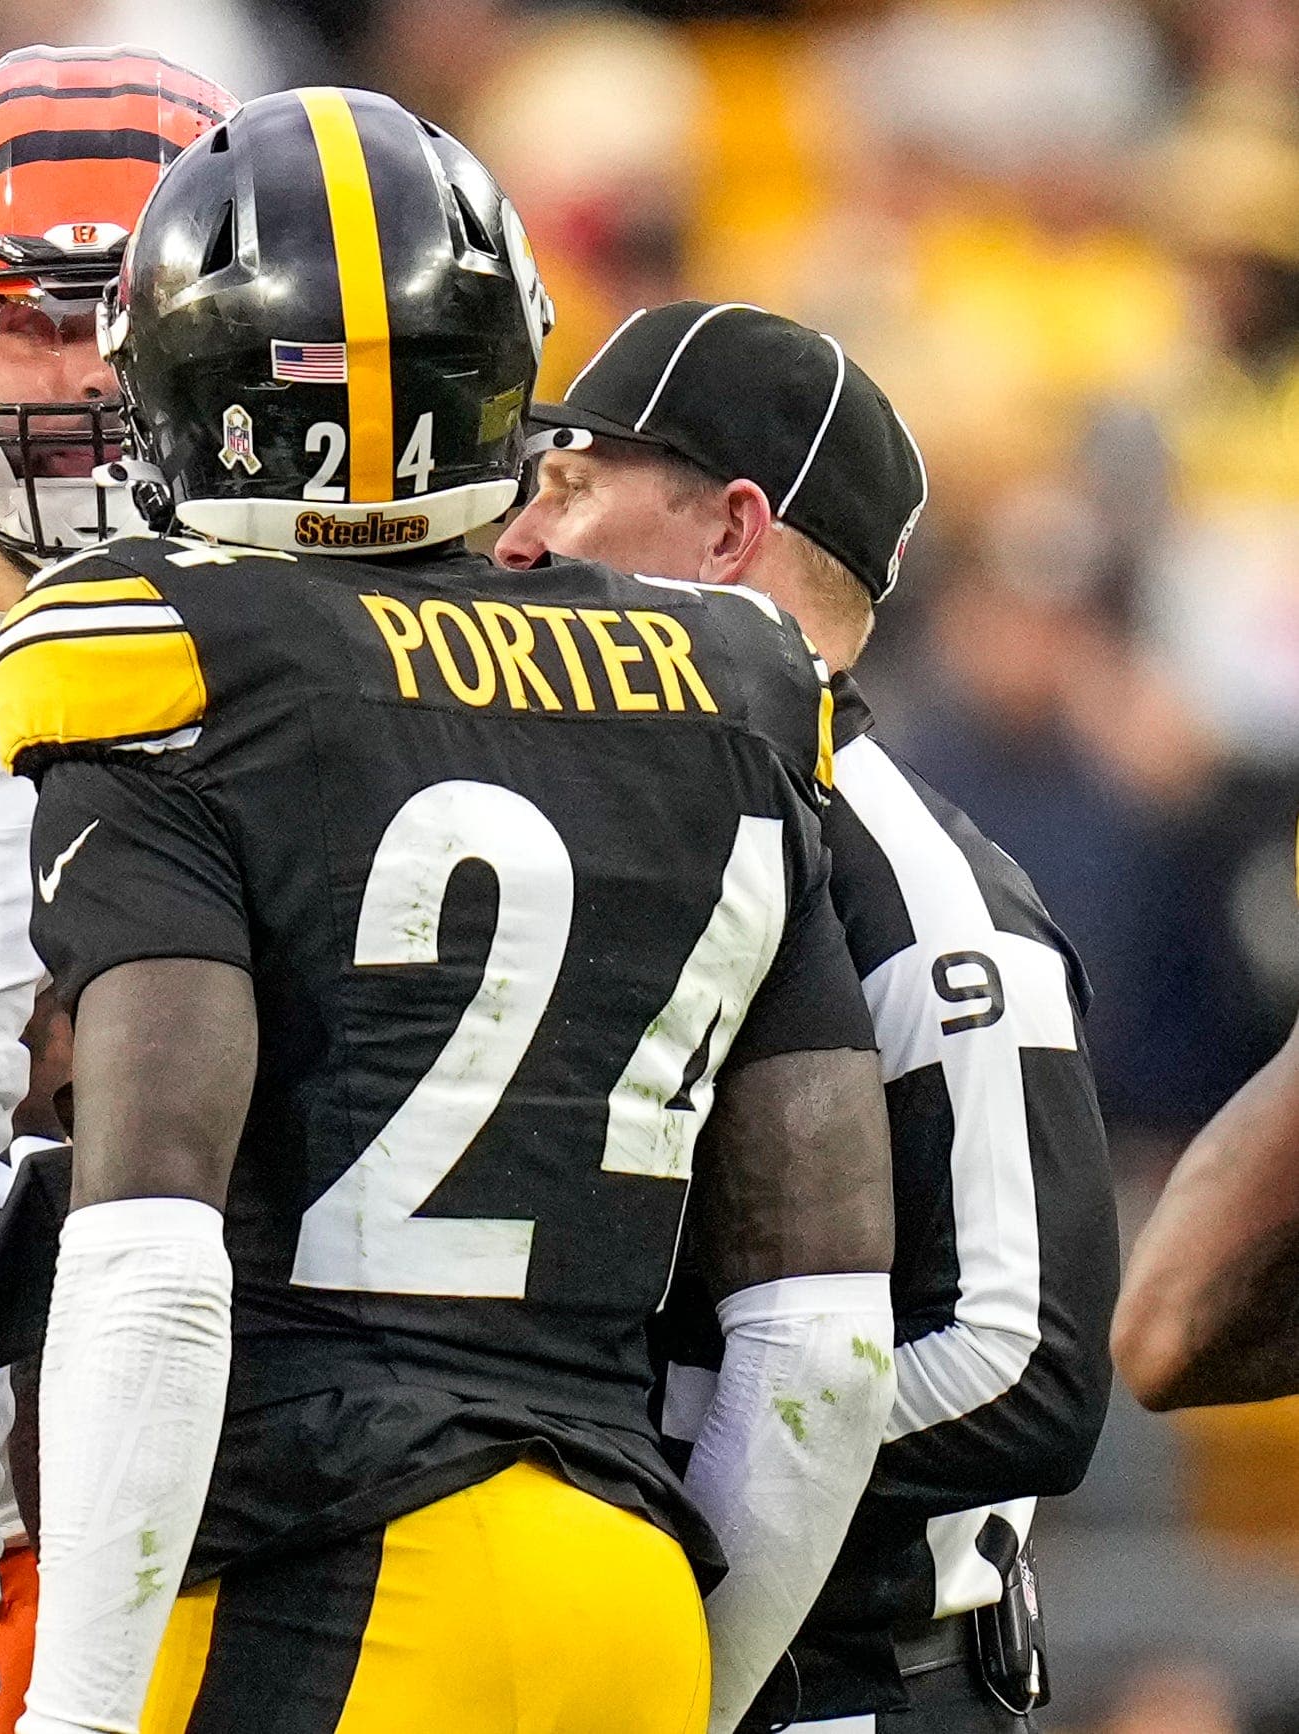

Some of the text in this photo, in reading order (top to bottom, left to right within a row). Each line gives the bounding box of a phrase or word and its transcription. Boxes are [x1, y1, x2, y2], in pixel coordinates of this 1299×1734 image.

[295, 511, 429, 548] Steelers
[359, 594, 719, 714] PORTER
[931, 950, 1005, 1036] 9
